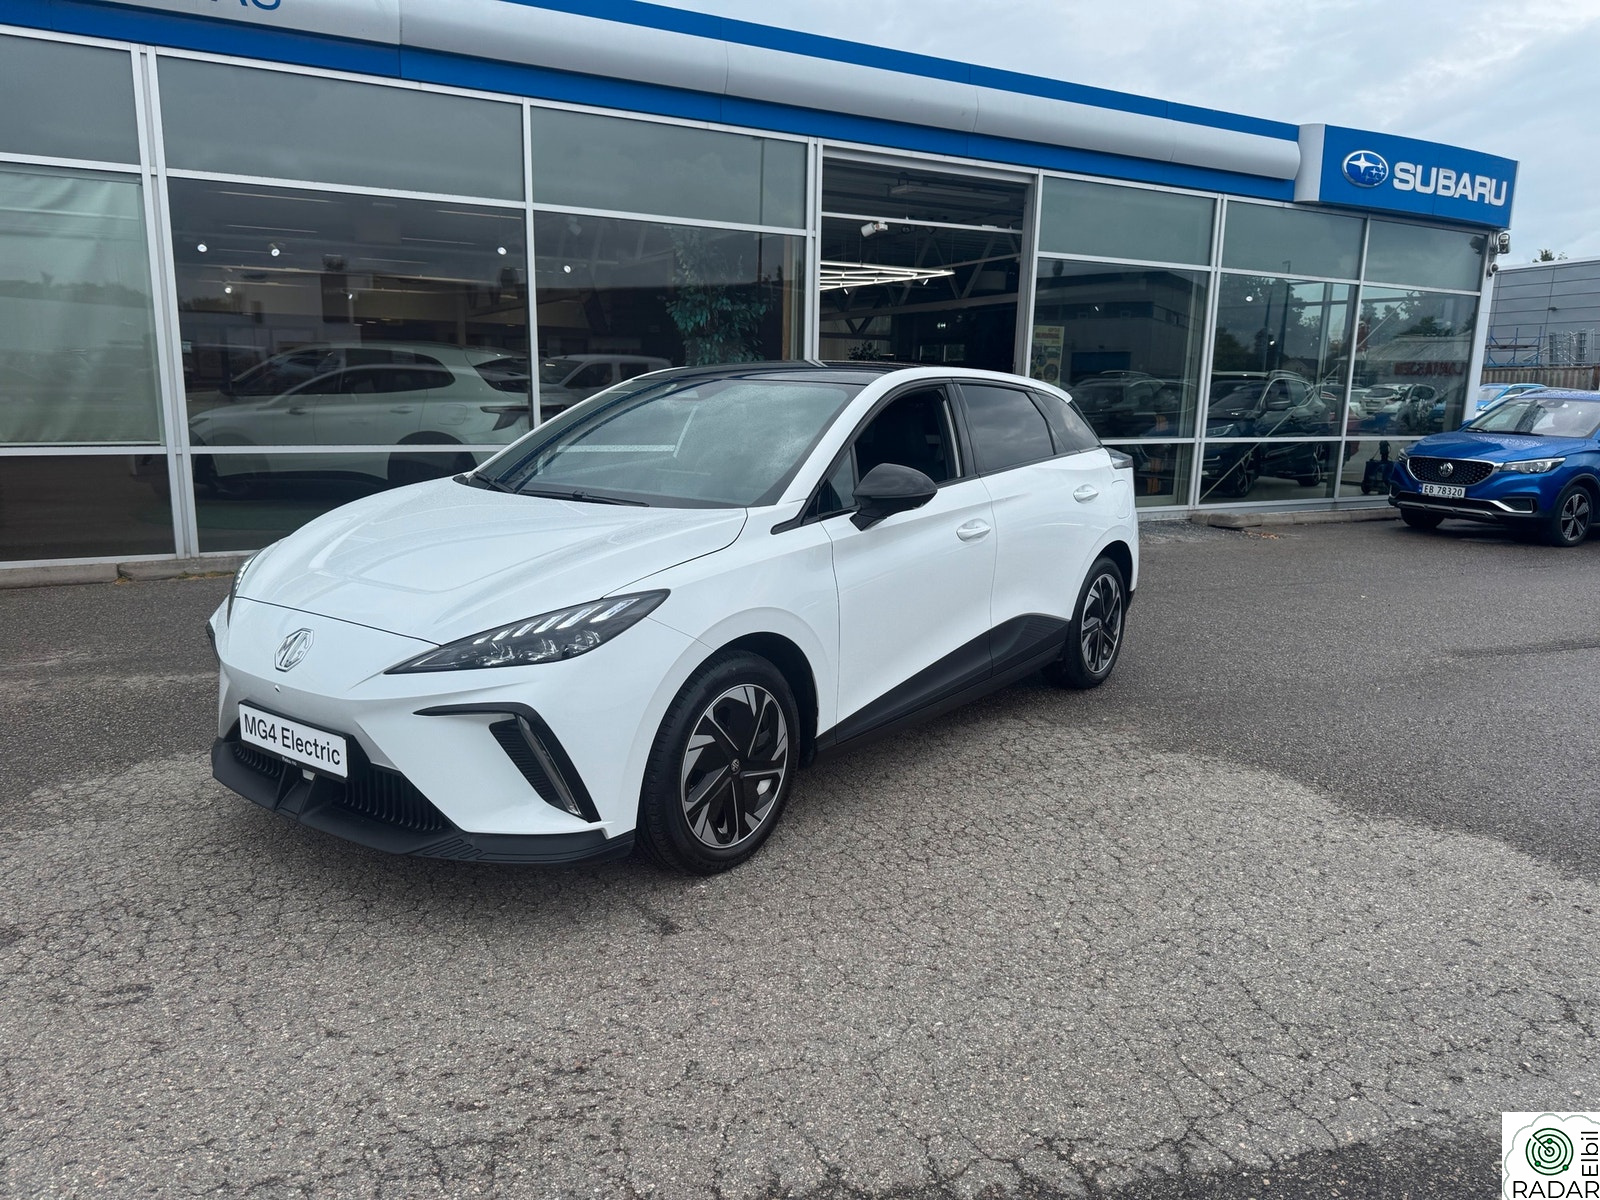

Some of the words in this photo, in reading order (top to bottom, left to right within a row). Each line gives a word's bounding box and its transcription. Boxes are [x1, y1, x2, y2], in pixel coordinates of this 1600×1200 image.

[1392, 161, 1507, 206] SUBARU
[1424, 485, 1434, 493] EB
[1437, 486, 1463, 496] 78320
[276, 630, 311, 670] MG
[244, 713, 277, 743] MG4
[281, 726, 341, 765] Electric
